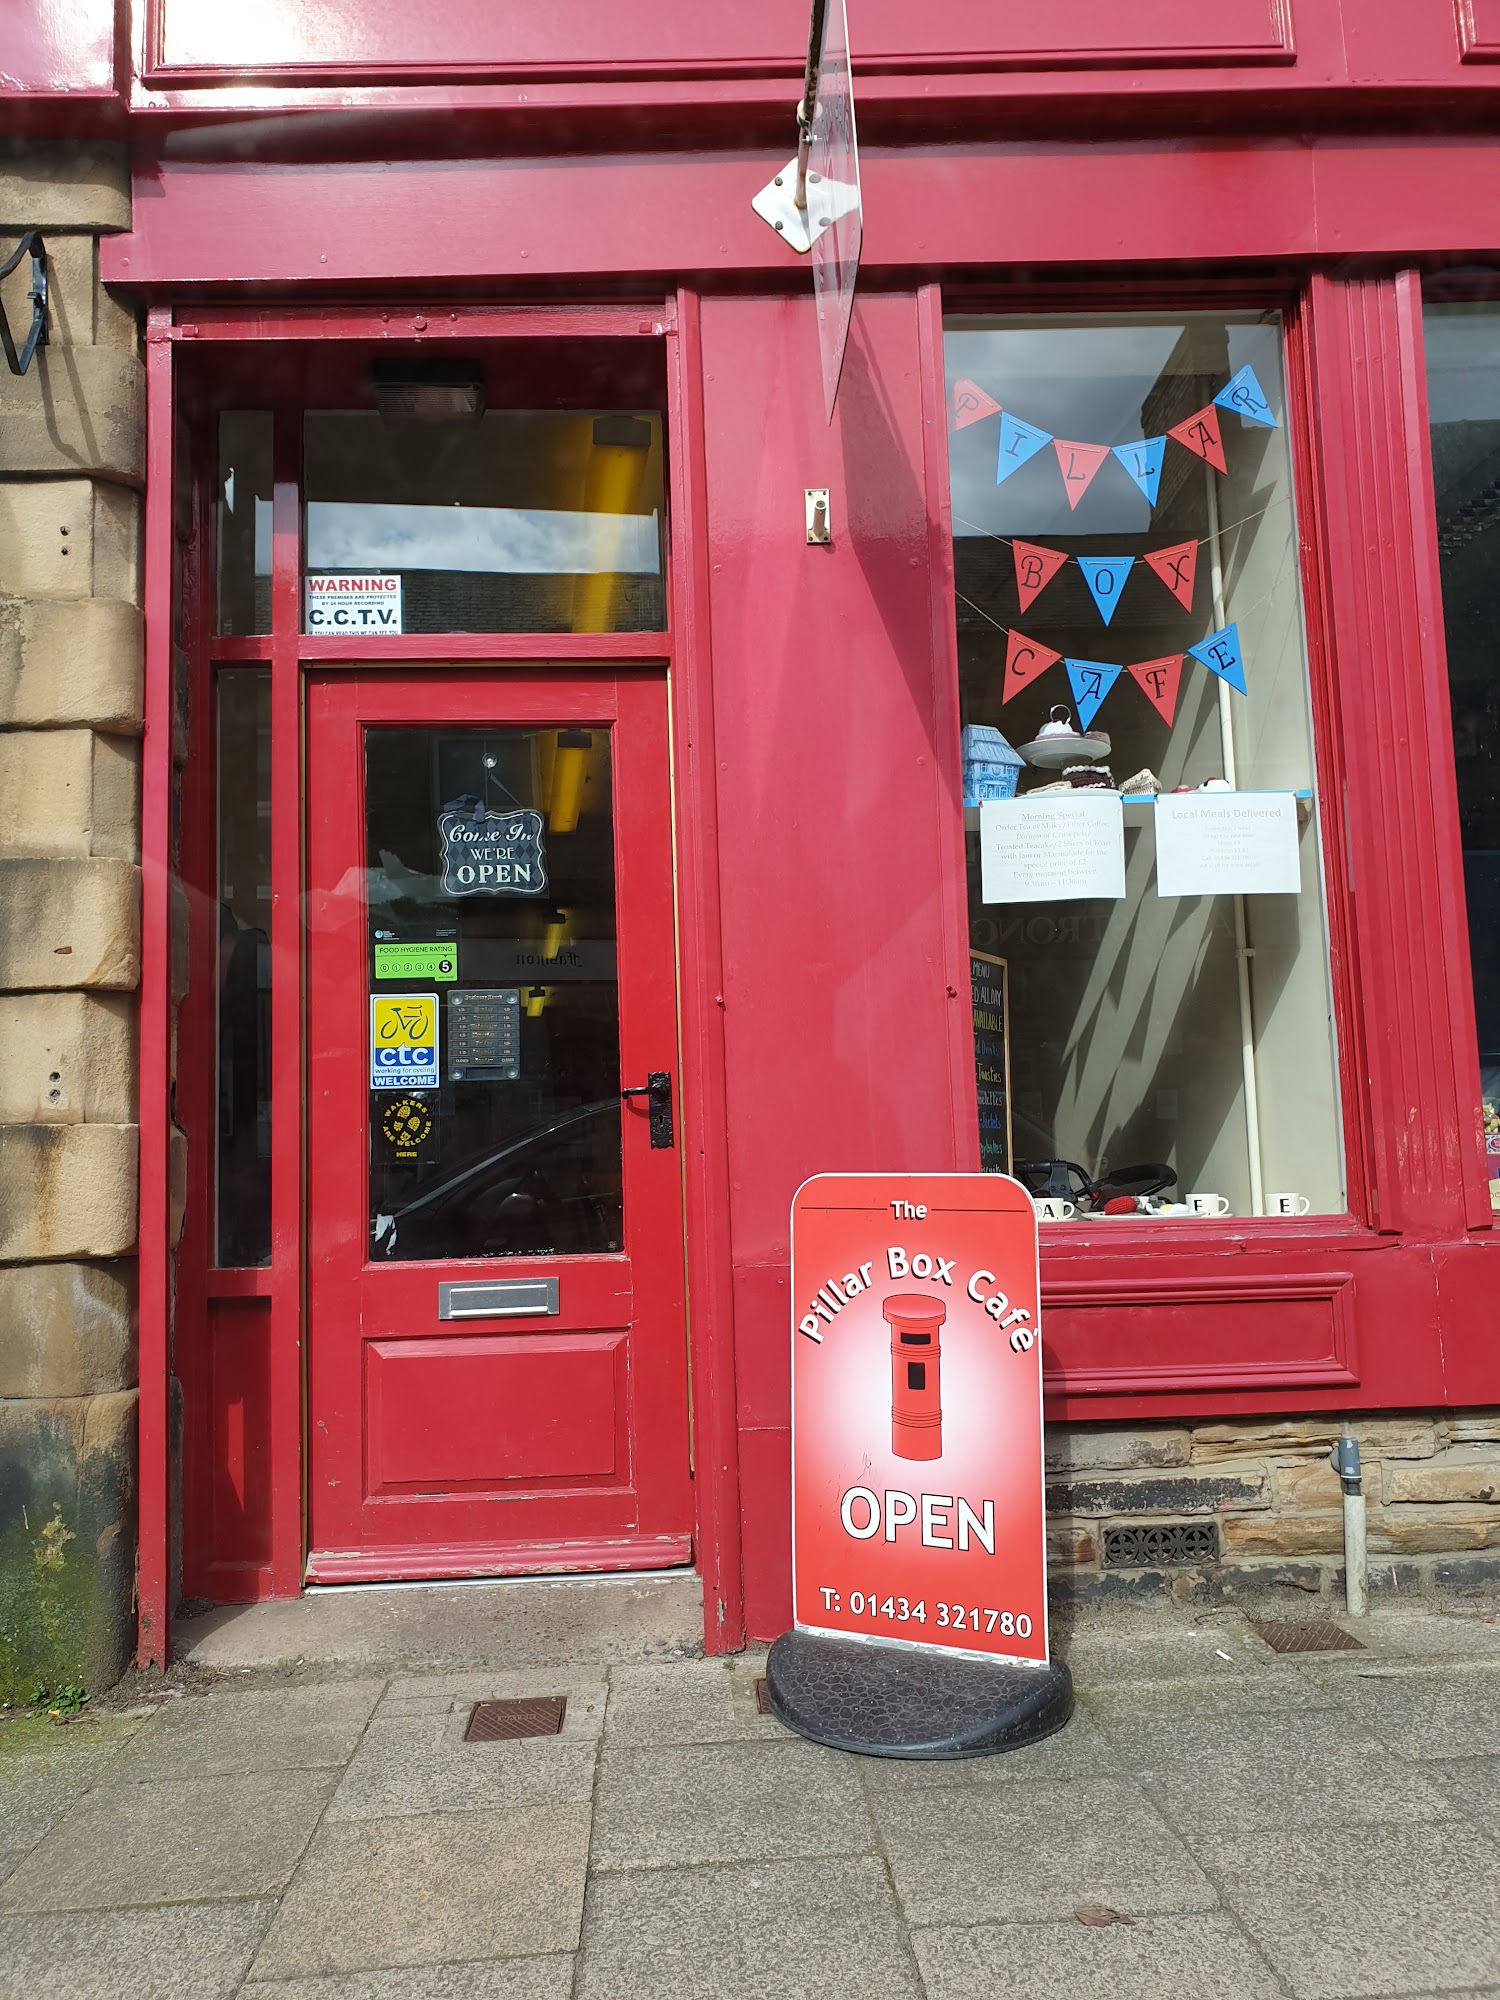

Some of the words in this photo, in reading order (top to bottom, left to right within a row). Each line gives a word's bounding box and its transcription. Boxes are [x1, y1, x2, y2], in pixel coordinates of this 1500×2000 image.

[952, 385, 1269, 481] PILLAR
[1021, 555, 1190, 595] BOX
[309, 579, 396, 591] WARNING
[309, 609, 397, 625] C.C.T.V.
[1011, 641, 1235, 705] CAFE
[1057, 811, 1085, 819] Special
[1172, 810, 1197, 819] Local
[1200, 809, 1230, 818] Meals
[1234, 808, 1281, 818] Delivered
[470, 847, 515, 860] WE'RE
[457, 863, 531, 884] OPEN
[442, 961, 449, 972] 5
[973, 961, 990, 978] MENU
[380, 1042, 428, 1065] ctc
[375, 1076, 434, 1086] WELCOME
[384, 1100, 427, 1117] WALKERS
[383, 1126, 395, 1142] ARE
[397, 1121, 432, 1146] WELCOME
[891, 1200, 927, 1219] The
[1280, 1199, 1290, 1212] E
[799, 1261, 873, 1344] Pillar
[887, 1246, 956, 1285] Box
[967, 1269, 1038, 1352] Café
[840, 1486, 995, 1555] OPEN
[819, 1587, 841, 1612] T:
[850, 1591, 927, 1624] 01434
[935, 1602, 1033, 1639] 321780
